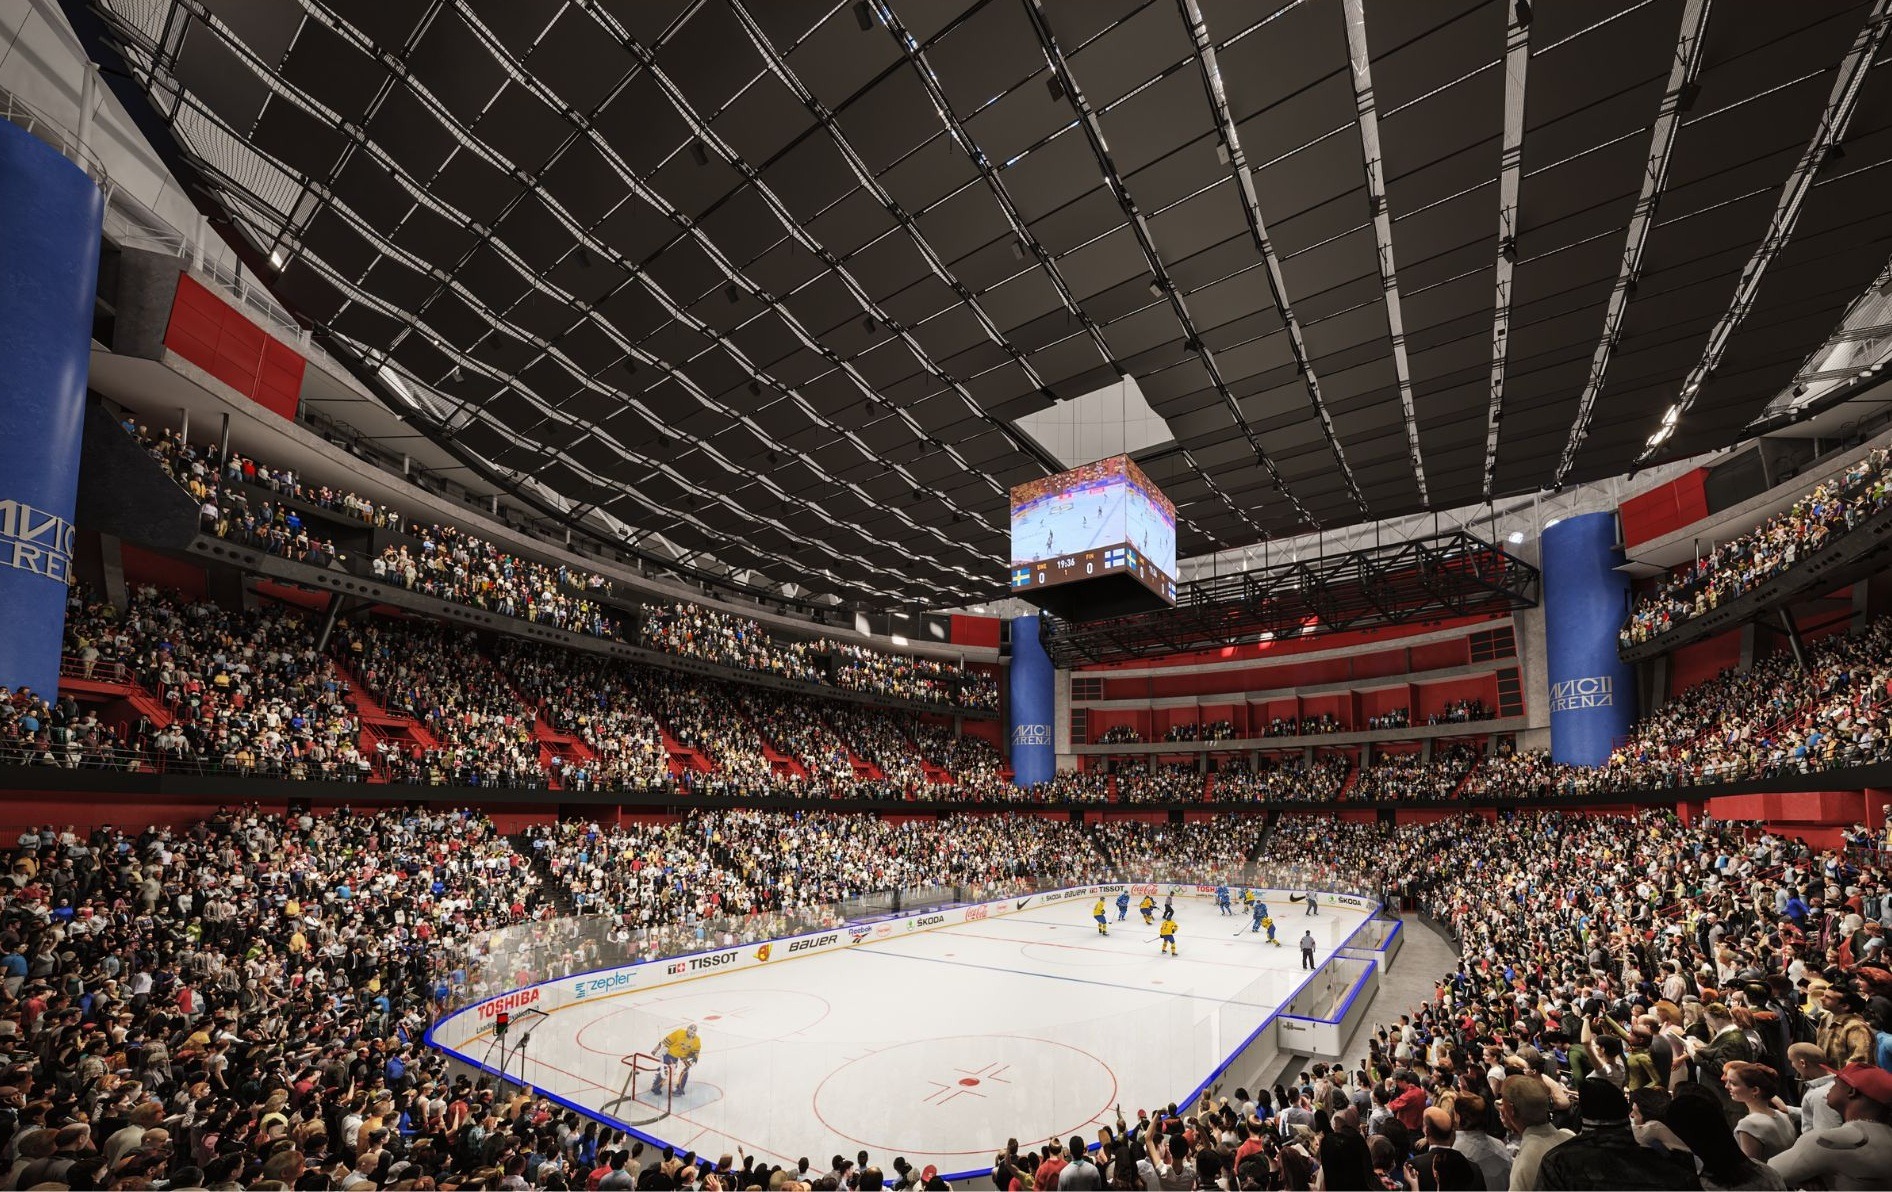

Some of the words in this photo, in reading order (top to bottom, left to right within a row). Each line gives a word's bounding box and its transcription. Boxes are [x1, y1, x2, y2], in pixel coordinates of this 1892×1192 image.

[1057, 558, 1075, 569] 19:36
[1086, 562, 1093, 574] 0
[1038, 572, 1045, 584] 0
[1549, 676, 1612, 698] AVICII
[1011, 725, 1050, 737] AVICII
[1012, 736, 1050, 745] ARENA
[917, 915, 944, 927] ŠKODA
[848, 926, 873, 935] Reebok
[689, 952, 738, 970] TISSOT
[587, 971, 637, 992] zepter
[477, 988, 539, 1020] TOSHIBA
